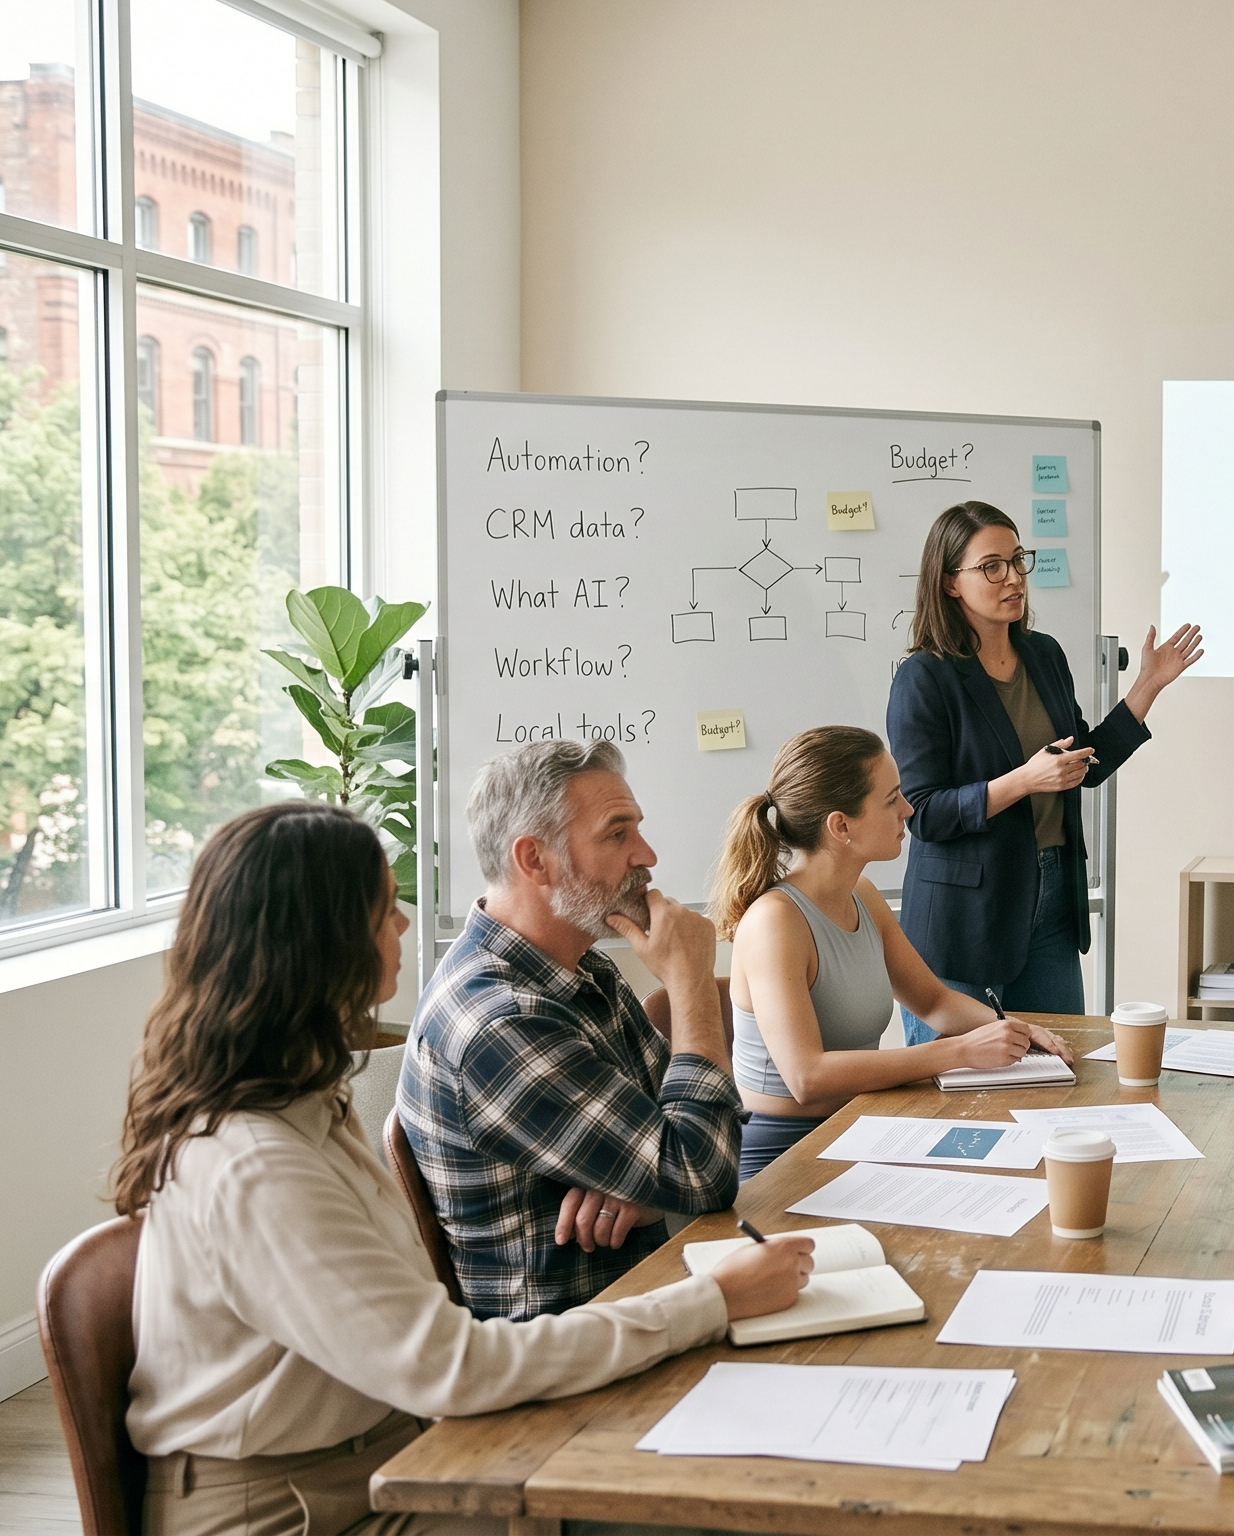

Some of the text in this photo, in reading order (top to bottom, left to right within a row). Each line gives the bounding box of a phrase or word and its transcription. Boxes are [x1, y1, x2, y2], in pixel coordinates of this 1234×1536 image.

[486, 437, 650, 474] Automation?
[890, 443, 974, 477] Budget?
[486, 507, 645, 540] CRM data?
[490, 576, 630, 610] What AI?
[494, 644, 633, 679] Workflow?
[496, 710, 656, 744] Local tools?
